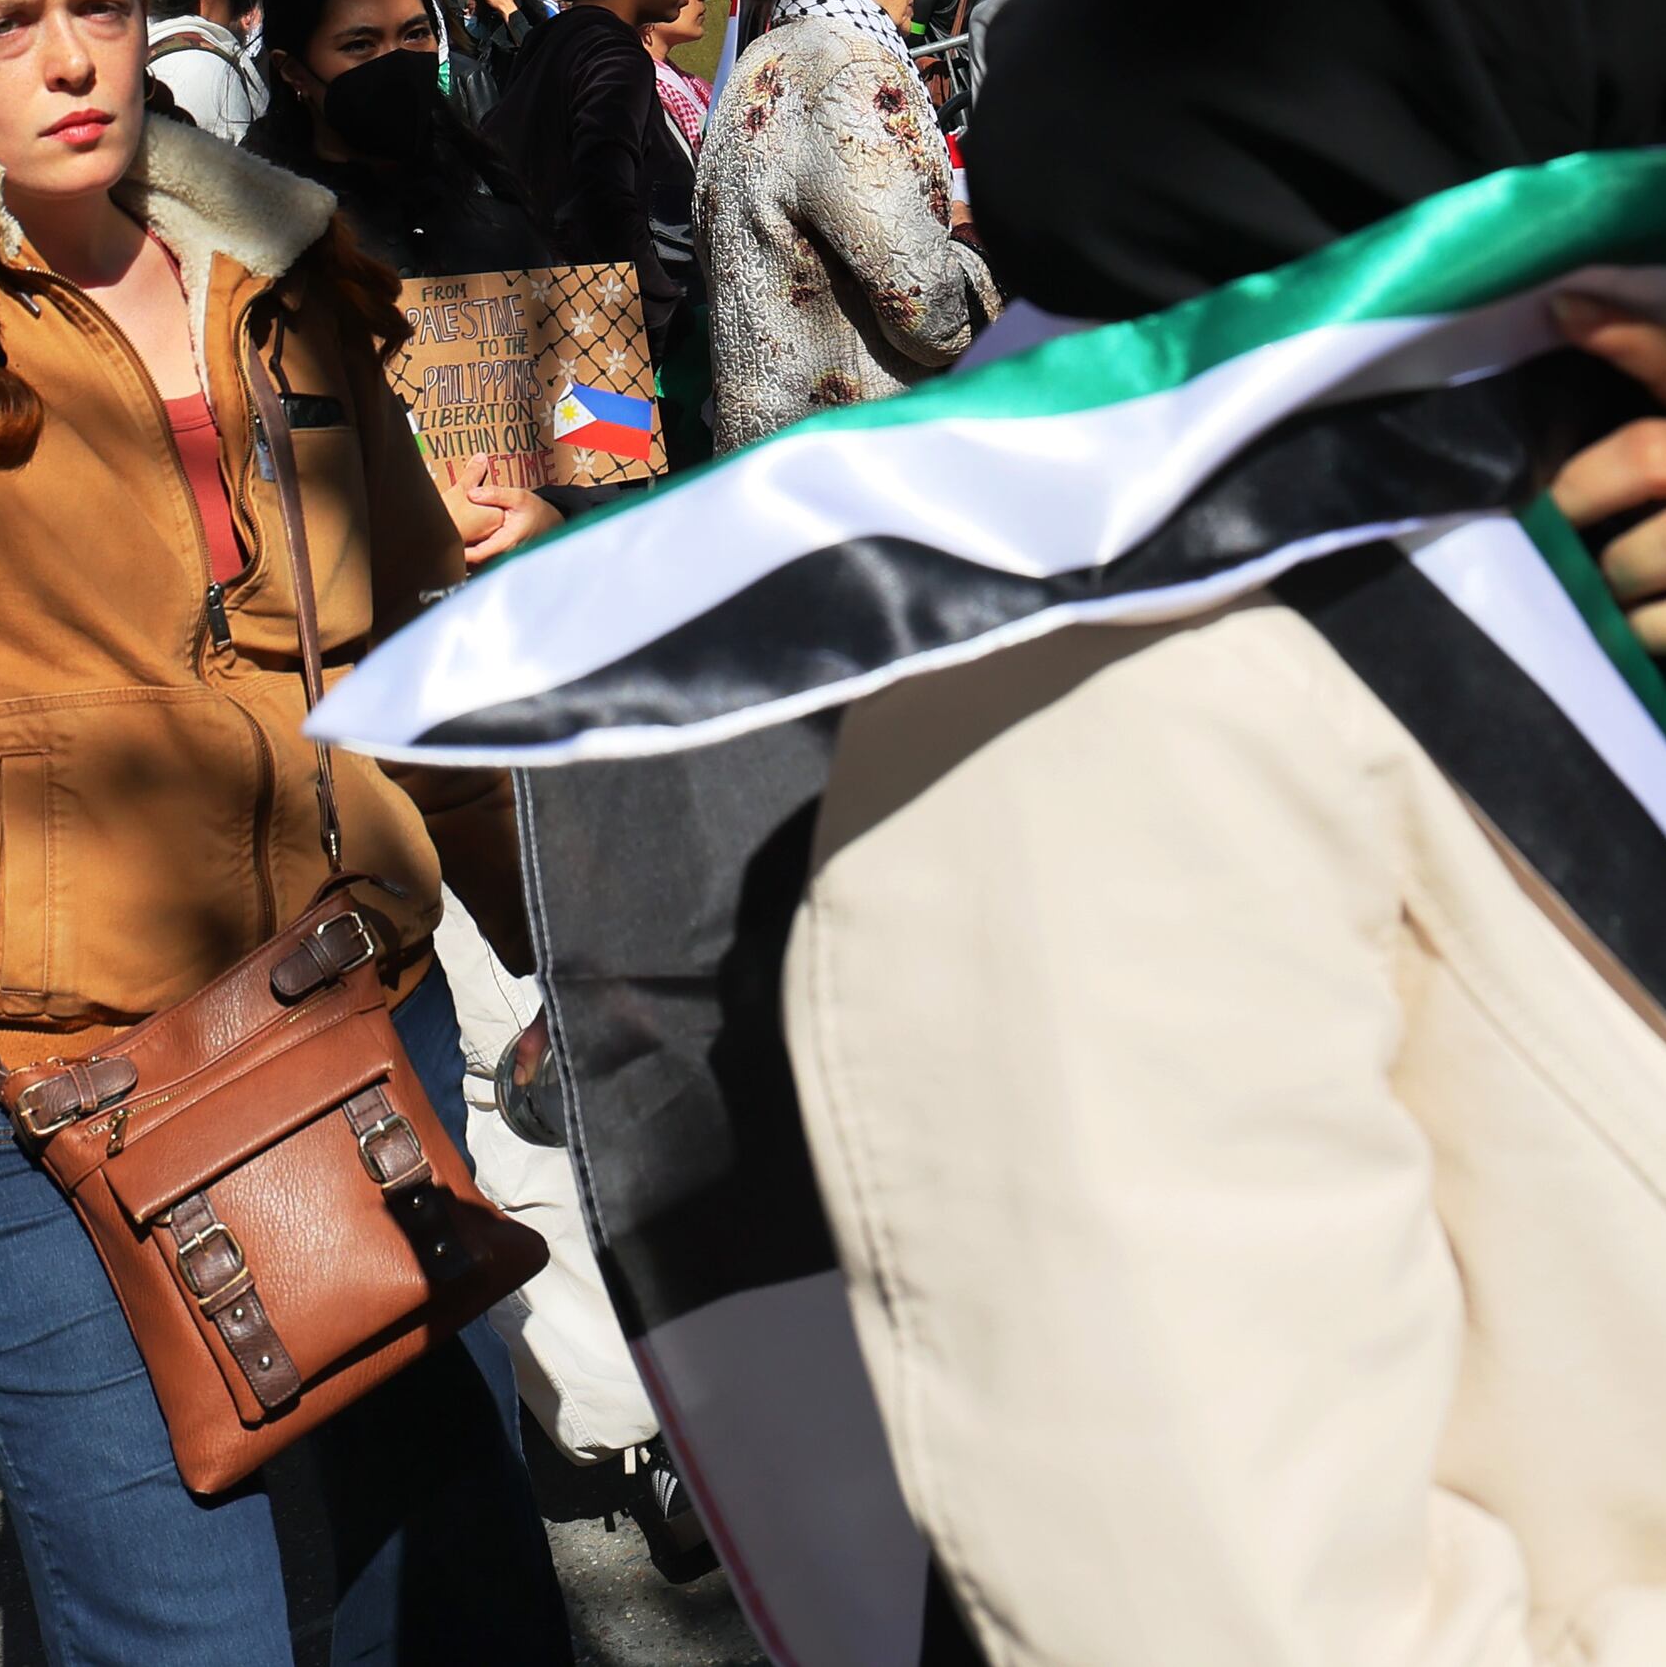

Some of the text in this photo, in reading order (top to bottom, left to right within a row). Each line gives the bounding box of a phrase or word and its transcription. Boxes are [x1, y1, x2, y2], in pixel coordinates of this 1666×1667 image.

[421, 283, 467, 302] FROM
[405, 294, 528, 346] PALESTINE
[476, 335, 529, 357] TO THE
[424, 358, 543, 409] PHILIPPINES
[417, 399, 533, 432] LIBERATION
[425, 422, 548, 460] WITHIN OUR
